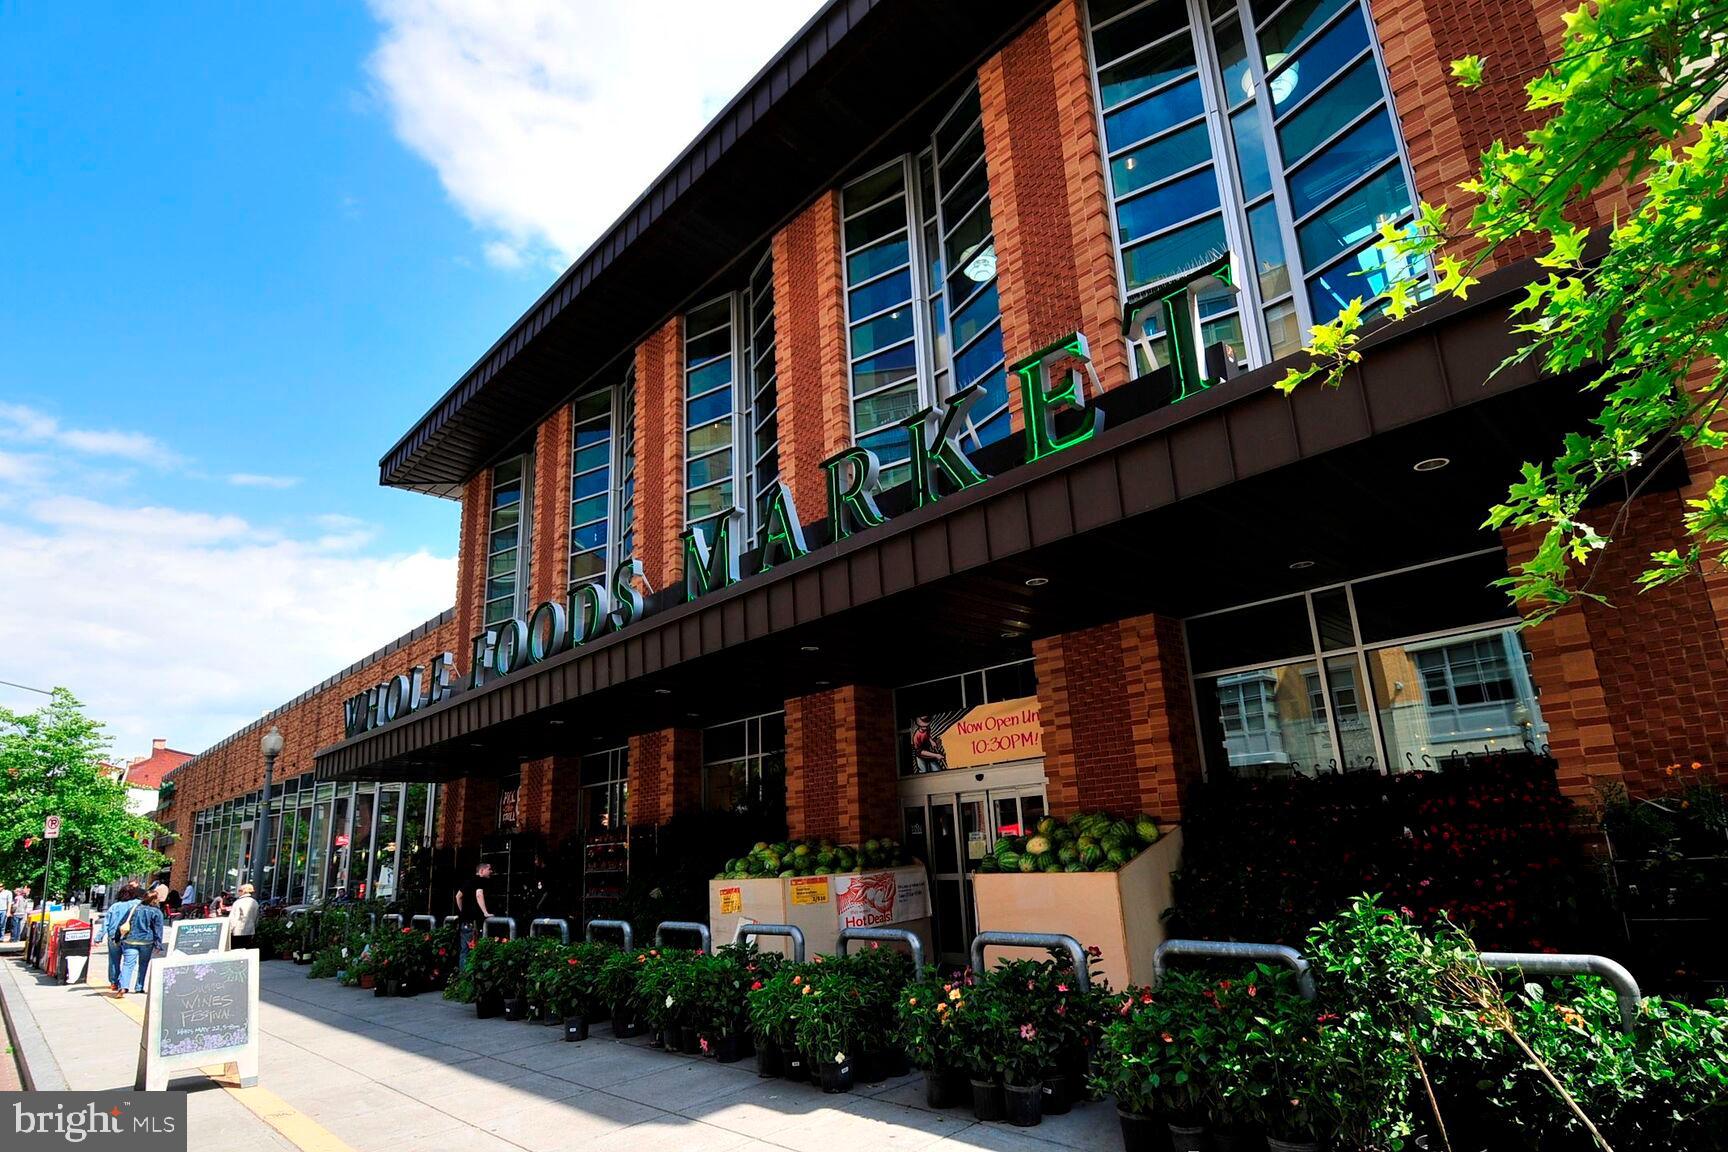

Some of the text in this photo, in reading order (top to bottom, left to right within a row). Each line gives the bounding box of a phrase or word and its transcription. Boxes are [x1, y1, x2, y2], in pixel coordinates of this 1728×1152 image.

[343, 248, 1242, 738] WHOLE FOODS MARKET
[957, 720, 983, 736] Now
[985, 716, 1020, 732] Open
[972, 731, 1039, 755] 10:30PM!
[845, 911, 893, 928] Hot Deals!
[181, 994, 234, 1009] WINES
